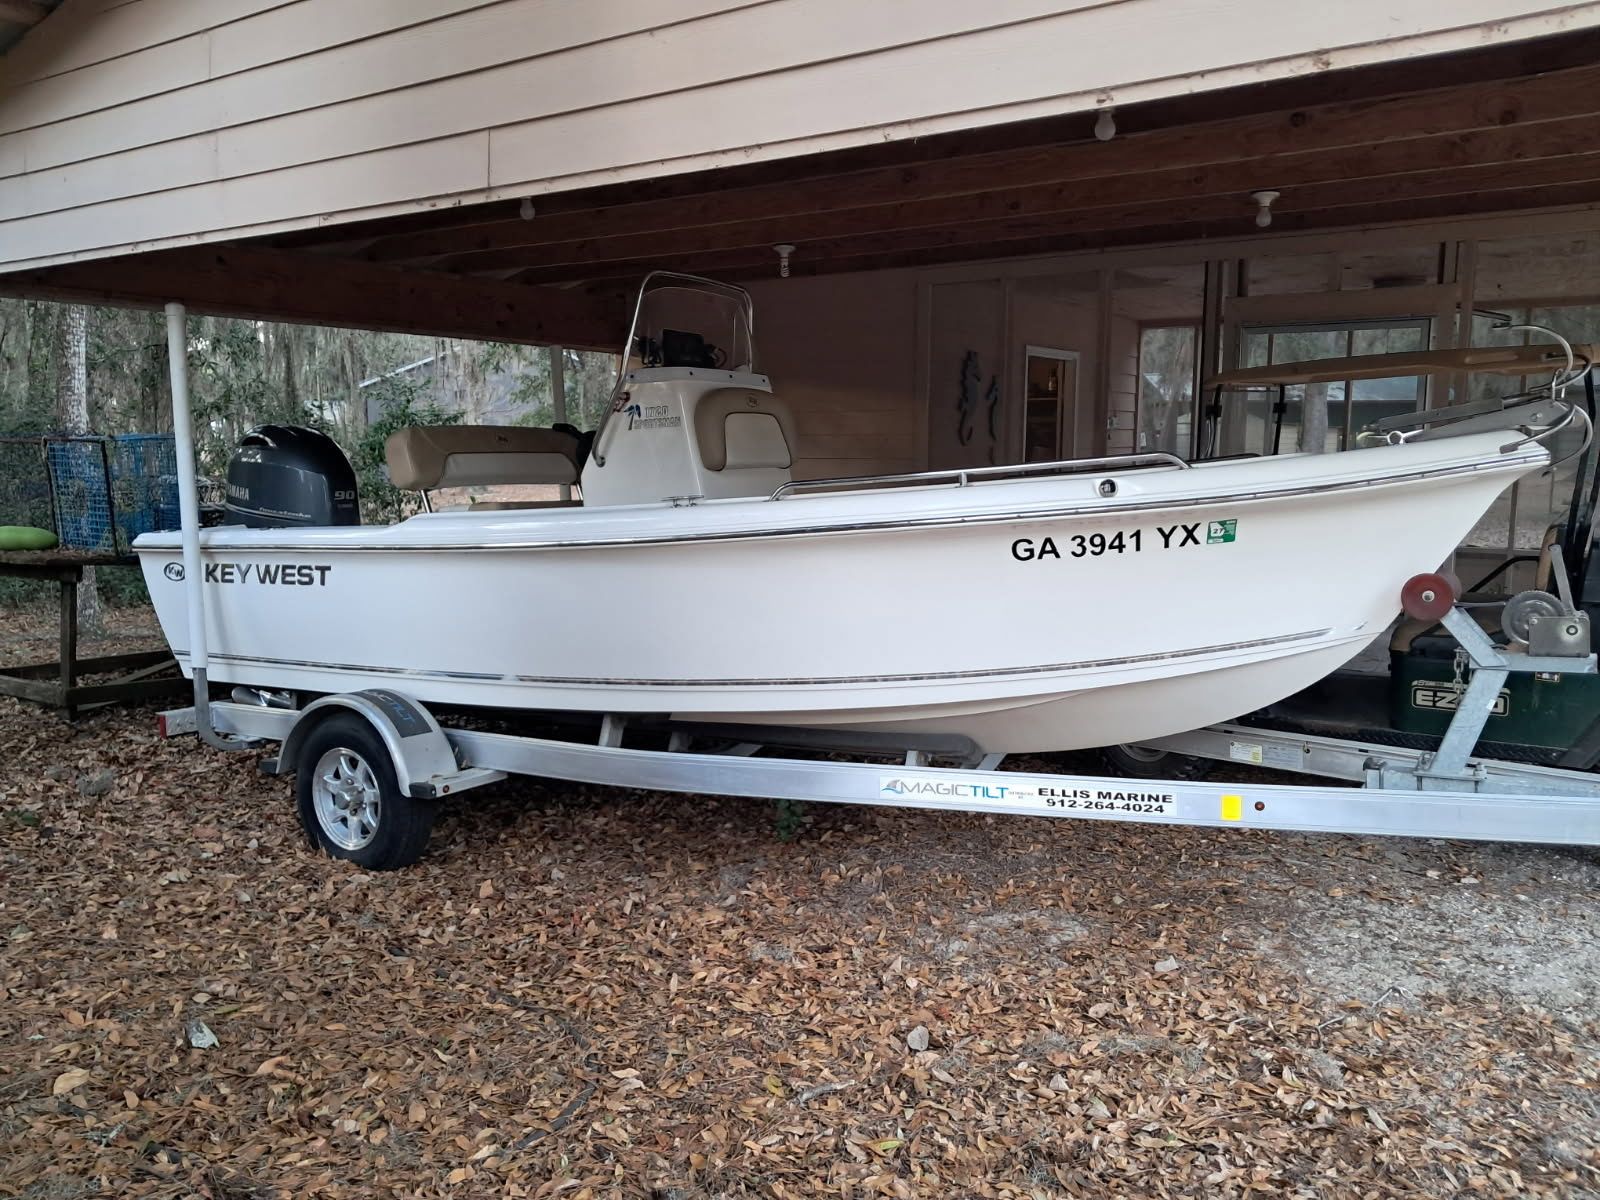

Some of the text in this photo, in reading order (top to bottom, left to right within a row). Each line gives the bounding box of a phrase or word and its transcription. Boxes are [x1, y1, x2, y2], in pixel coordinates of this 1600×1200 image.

[334, 490, 355, 500] 90
[1011, 523, 1202, 561] GA 3941 YX
[205, 563, 332, 586] KEY WEST
[900, 781, 1009, 800] MAGICTILT
[1038, 788, 1091, 800] ELLIS
[1097, 791, 1173, 804] MARINE
[1046, 798, 1165, 814] 912-264-4024
